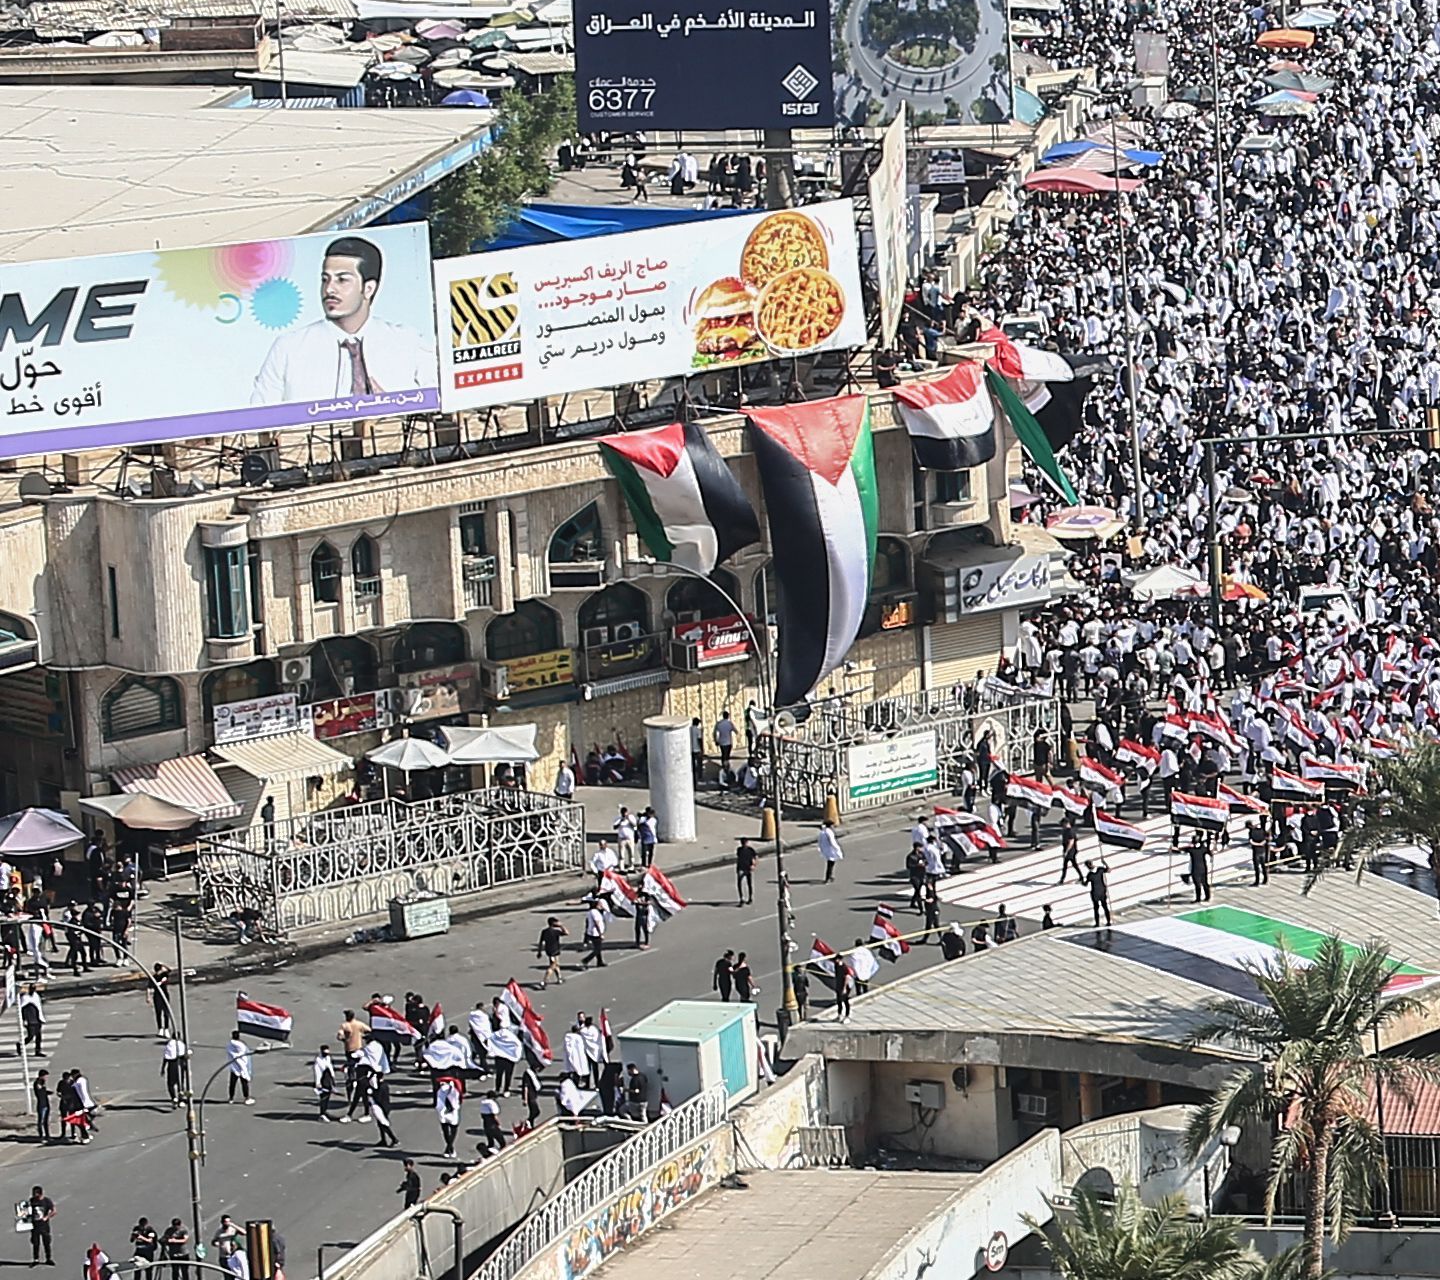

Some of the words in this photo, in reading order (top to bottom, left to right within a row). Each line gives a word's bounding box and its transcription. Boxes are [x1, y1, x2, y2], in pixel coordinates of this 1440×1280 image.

[656, 13, 682, 39] في
[588, 89, 657, 111] 6377
[533, 265, 595, 293] اكسبريس
[597, 260, 633, 283] الريف
[636, 256, 669, 279] صاج
[629, 303, 667, 324] بمول
[454, 348, 477, 364] SAJ
[478, 341, 521, 362] ALREEF
[537, 345, 566, 371] ستي
[570, 338, 615, 361] دريم
[457, 366, 520, 386] EXPRESS
[6, 393, 46, 416] خط
[53, 381, 103, 417] أقوى
